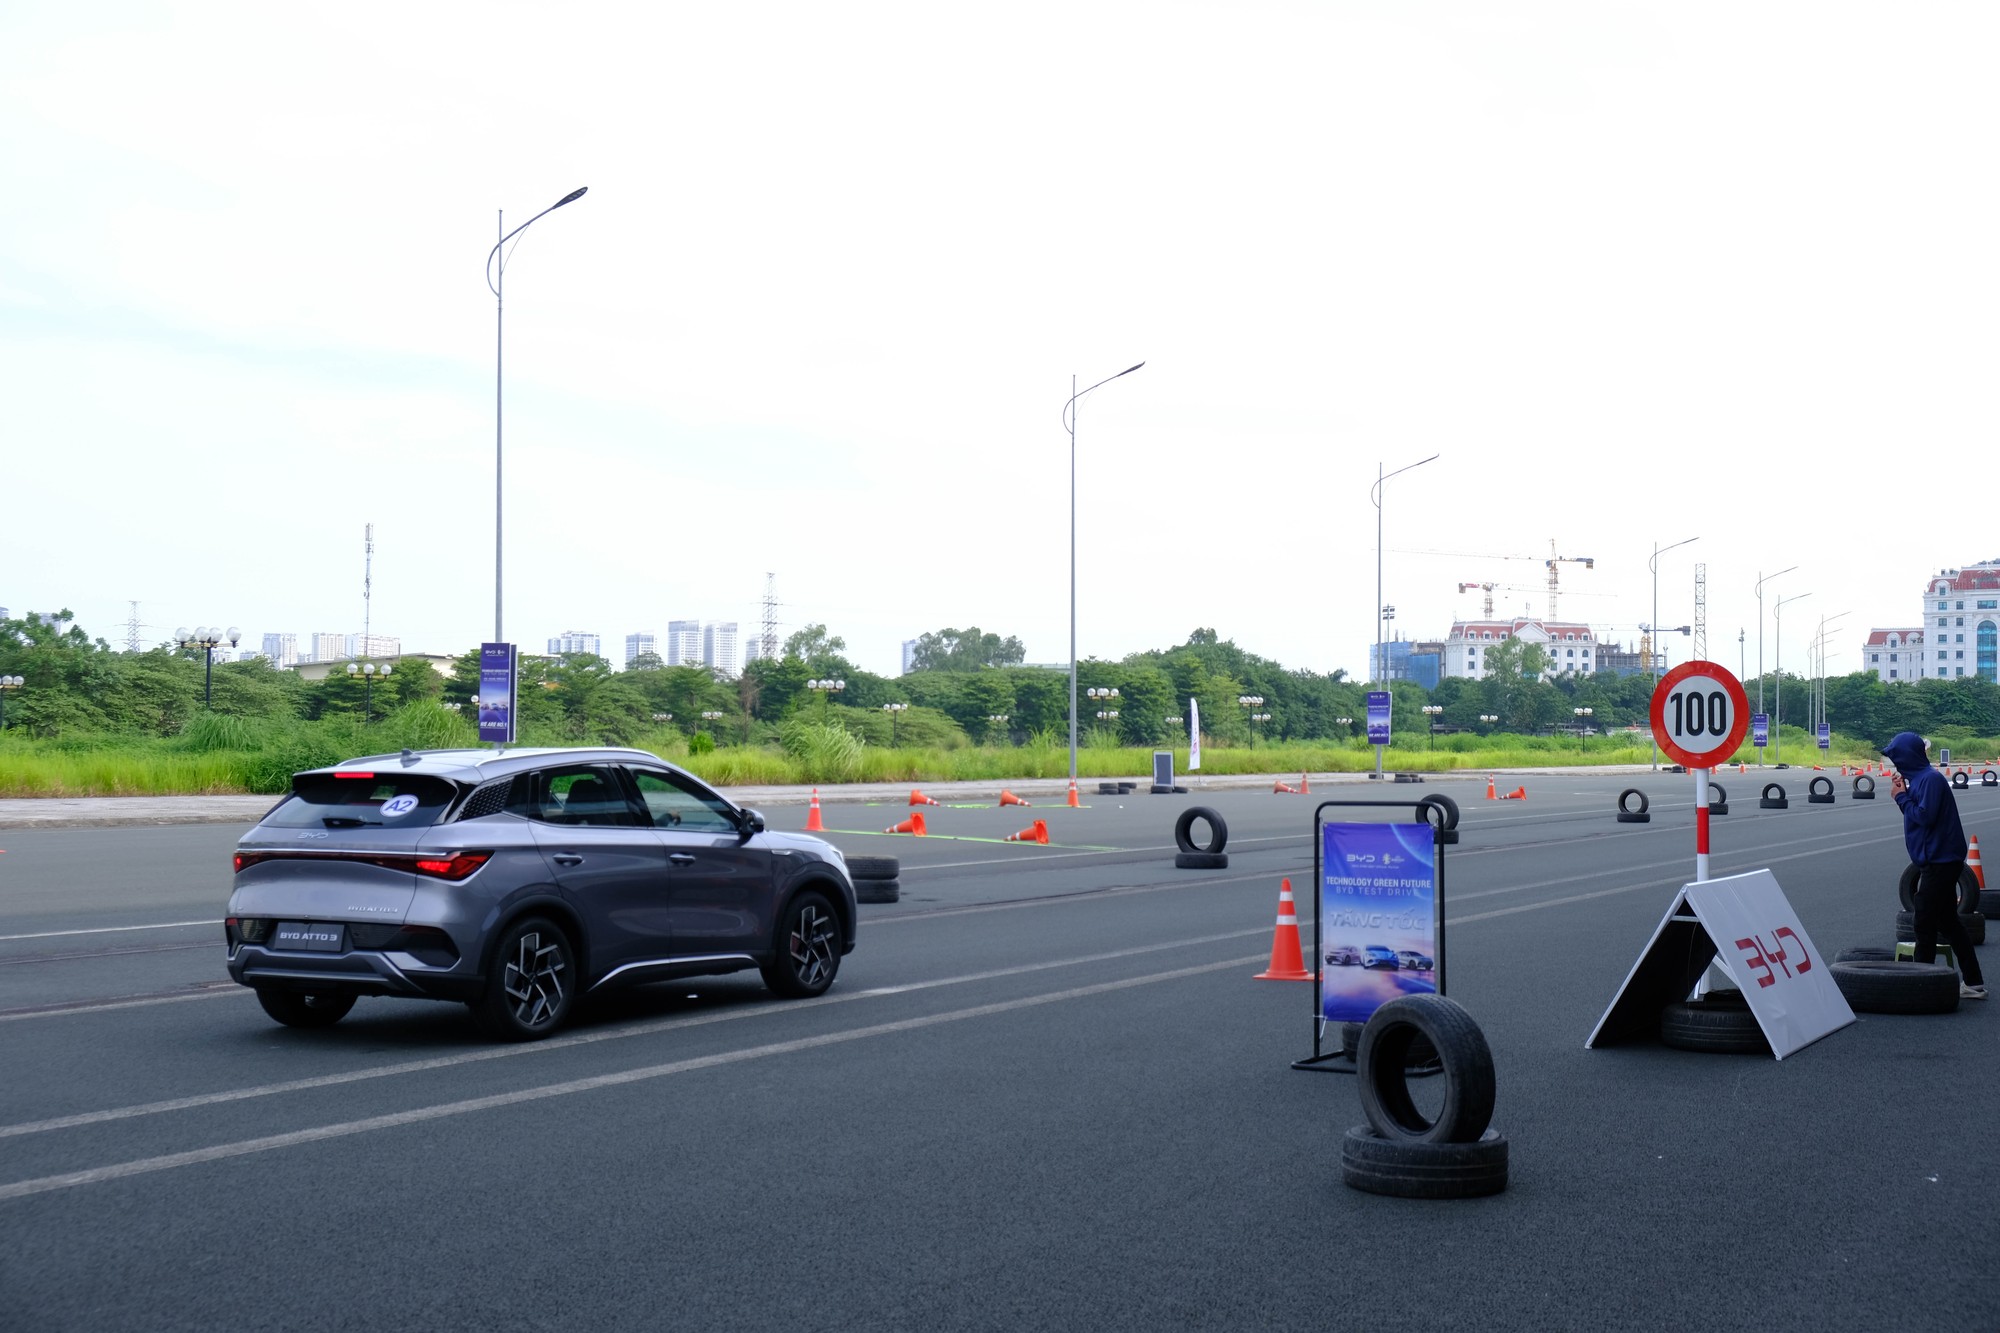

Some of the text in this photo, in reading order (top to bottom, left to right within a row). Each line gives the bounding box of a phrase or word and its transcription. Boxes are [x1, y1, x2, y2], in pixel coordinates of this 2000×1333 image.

[1670, 691, 1727, 737] 100
[384, 800, 413, 812] A2
[1346, 854, 1375, 863] BYD
[1326, 876, 1431, 888] TECHNOLOGY GREEN FUTURE
[1336, 886, 1354, 894] BYD
[1359, 887, 1383, 895] TEST
[1331, 909, 1382, 928] TĂNG
[301, 933, 328, 941] ATTO
[1735, 926, 1812, 988] BYD
